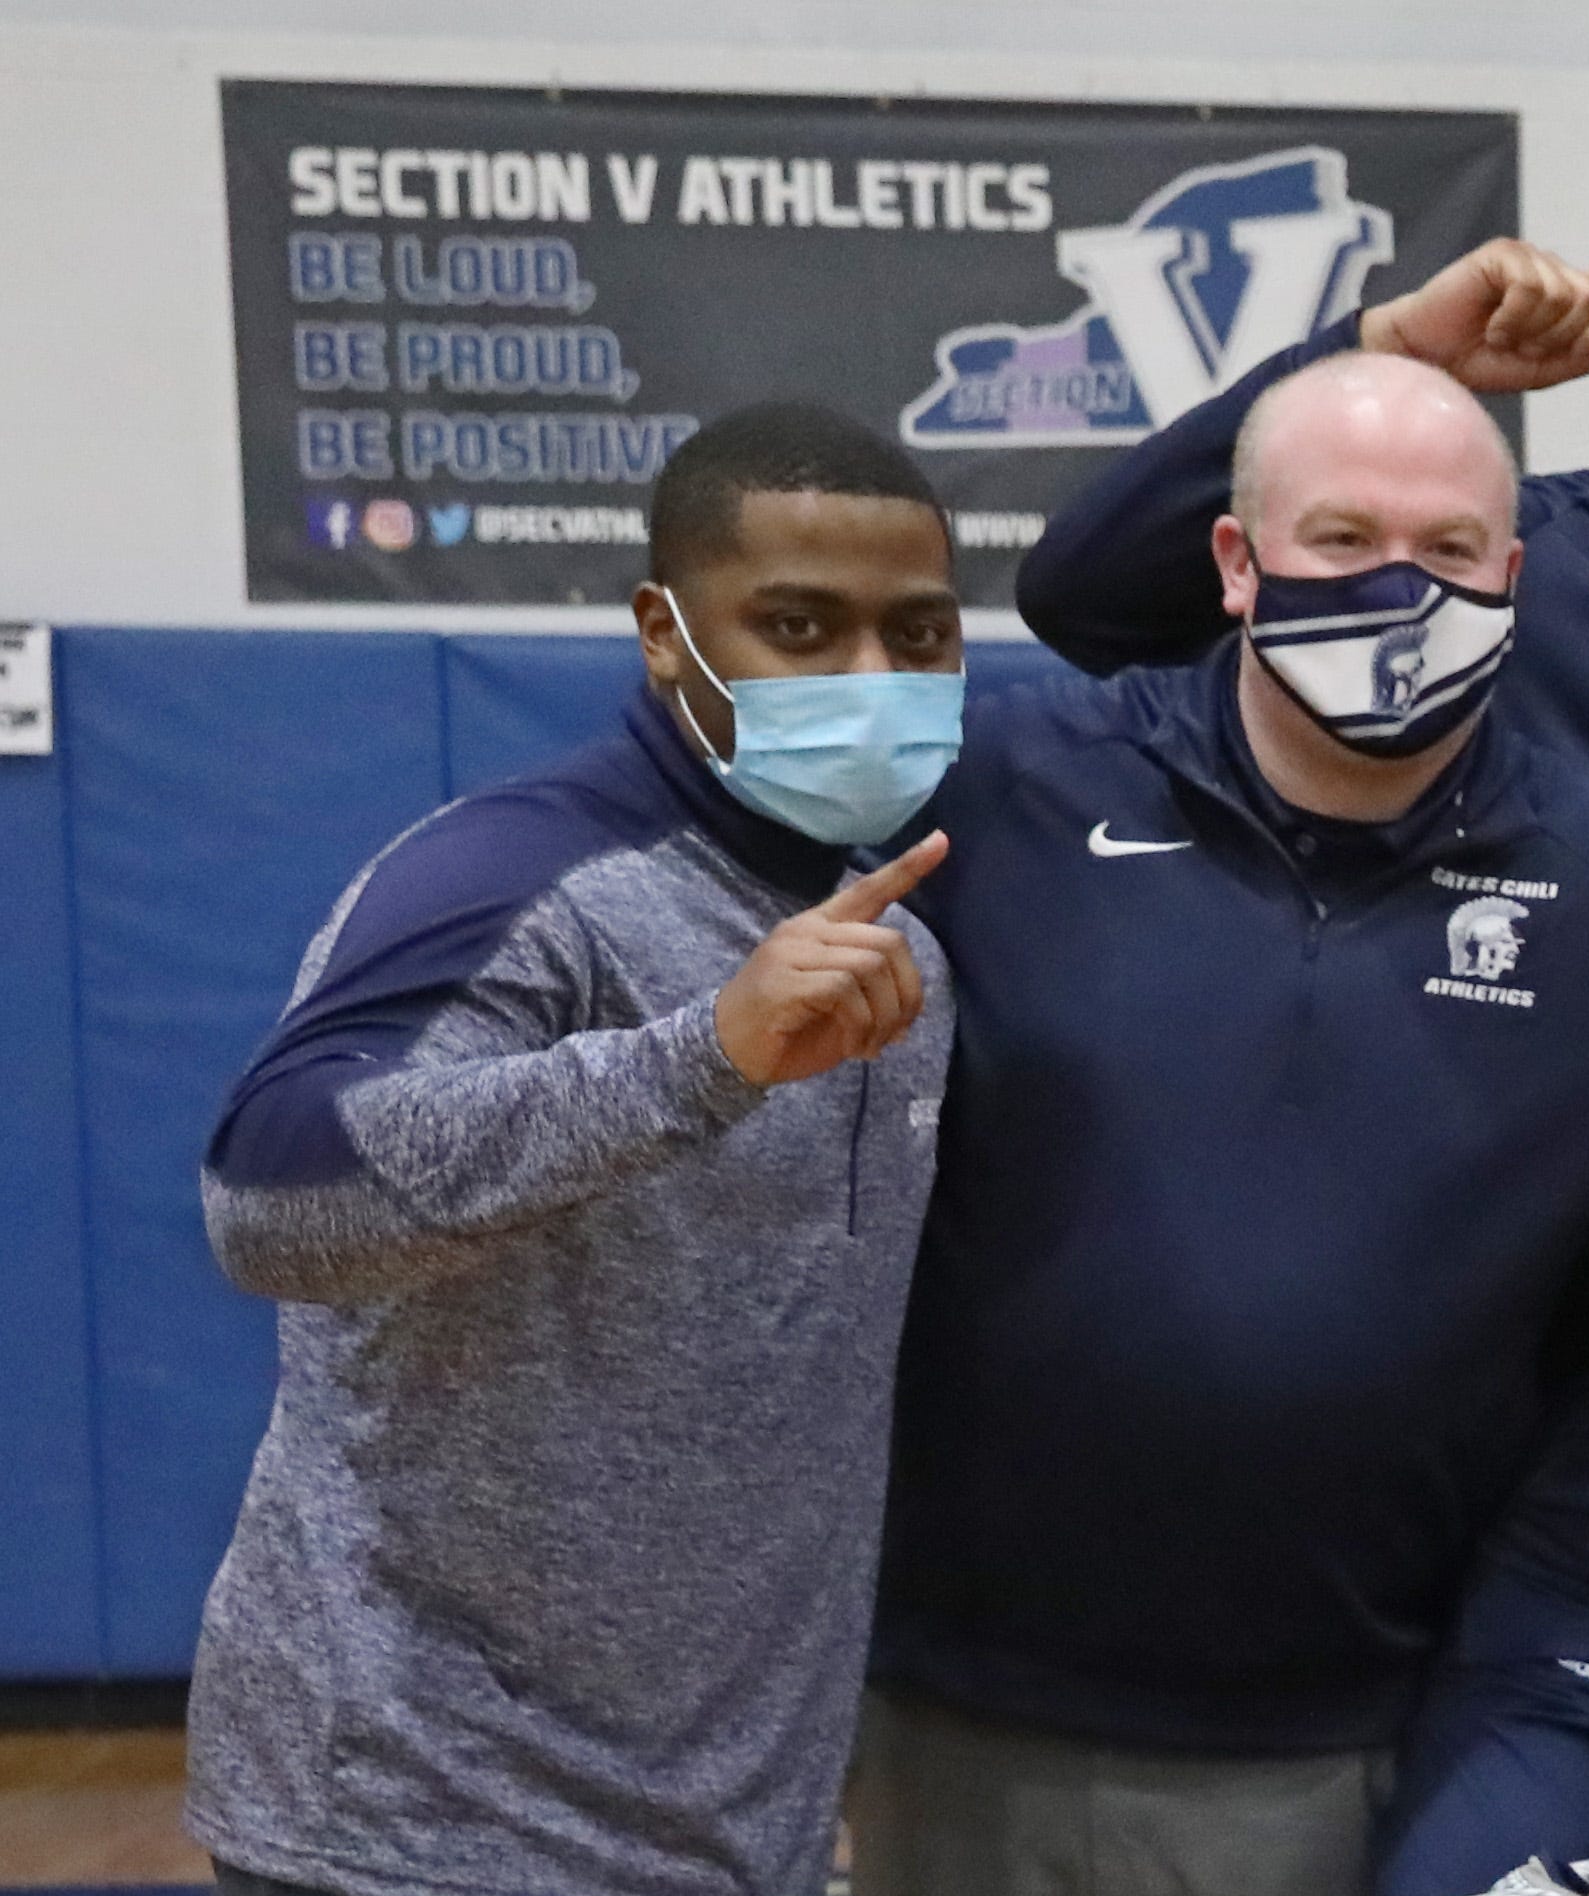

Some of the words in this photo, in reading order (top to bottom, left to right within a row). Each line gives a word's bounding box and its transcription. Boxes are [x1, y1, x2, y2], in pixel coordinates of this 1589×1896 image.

[289, 146, 592, 222] SECTION
[606, 152, 660, 224] V
[677, 154, 1053, 233] ATHLETICS
[289, 231, 386, 303] BE
[393, 232, 597, 316] LOUD,
[294, 321, 390, 392] BE
[398, 321, 641, 404] PROUD,
[297, 407, 395, 481] BE
[1431, 866, 1499, 893] GATES
[1500, 878, 1560, 900] CHILI
[1423, 976, 1536, 1008] ATHLETICS
